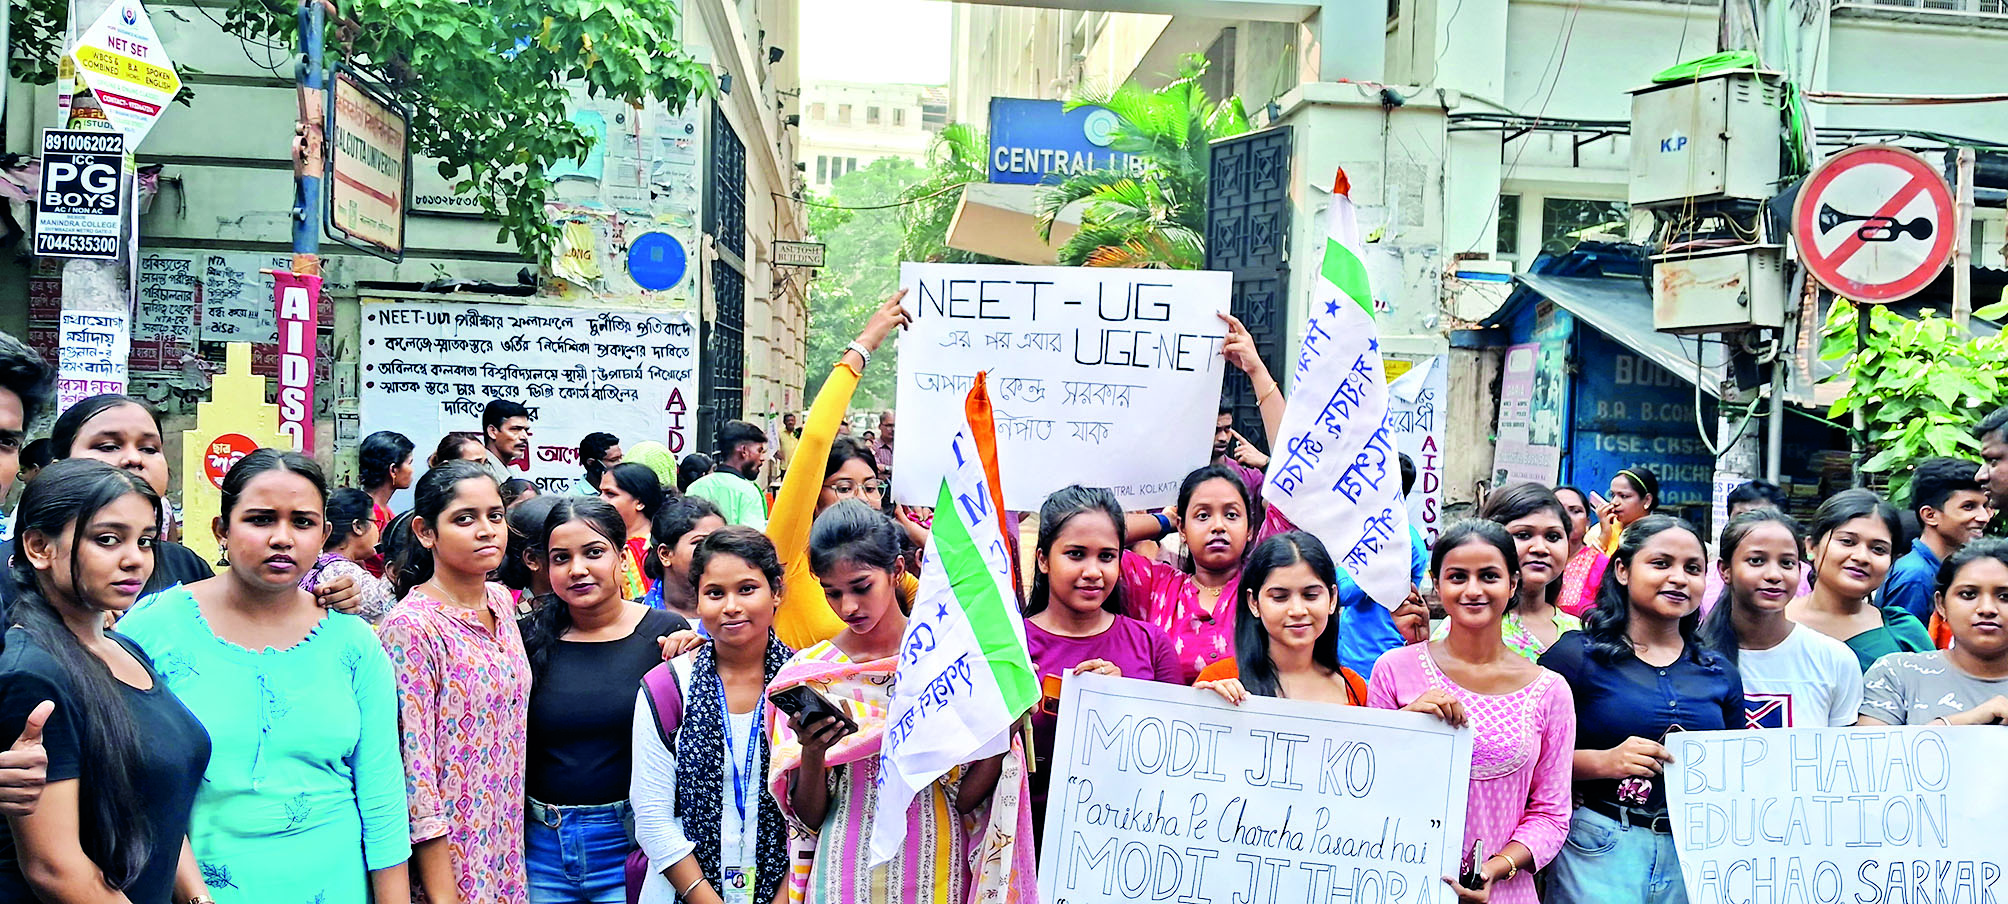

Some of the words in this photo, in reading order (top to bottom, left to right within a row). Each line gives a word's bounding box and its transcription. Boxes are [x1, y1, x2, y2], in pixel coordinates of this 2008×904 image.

[108, 35, 128, 52] NET
[130, 42, 148, 58] SET
[82, 59, 119, 75] COMBINED
[146, 67, 170, 80] SPOKEN
[145, 76, 171, 90] ENGLISH
[45, 134, 122, 152] 8910062022
[335, 125, 367, 164] CALCUTTA
[72, 155, 94, 165] ICC
[994, 146, 1094, 176] CENTRAL
[46, 162, 117, 194] PG
[45, 192, 116, 208] BOYS
[40, 219, 79, 227] MANINDRA
[81, 220, 117, 228] COLLEGE
[39, 234, 116, 253] 7044535300
[781, 245, 819, 255] ASUTOSH
[778, 253, 820, 263] BUILDING
[918, 278, 1054, 321] NEET
[1098, 281, 1173, 321] UG
[939, 330, 971, 349] এর
[984, 331, 1014, 352] পর
[1016, 332, 1062, 353] এবার
[1074, 328, 1226, 373] UGC-NET
[1000, 377, 1046, 403] কেন্দ্র
[1061, 380, 1148, 408] সরকার
[1066, 421, 1113, 445] যাক
[1139, 481, 1178, 496] KOLKATA
[1082, 708, 1232, 783] MODI
[1244, 729, 1309, 791] JI
[1317, 738, 1376, 799] KO
[1683, 736, 1769, 795] BJP
[1790, 730, 1951, 793] HATAO
[1188, 793, 1208, 841] Pe
[1217, 797, 1304, 852] Charcha
[1309, 808, 1388, 861] Pasand
[1685, 794, 1949, 851] EDUCATION
[1067, 831, 1219, 904] MODI
[1232, 854, 1291, 904] JI
[1300, 861, 1432, 904] THORA
[1855, 859, 2001, 904] SARKAR
